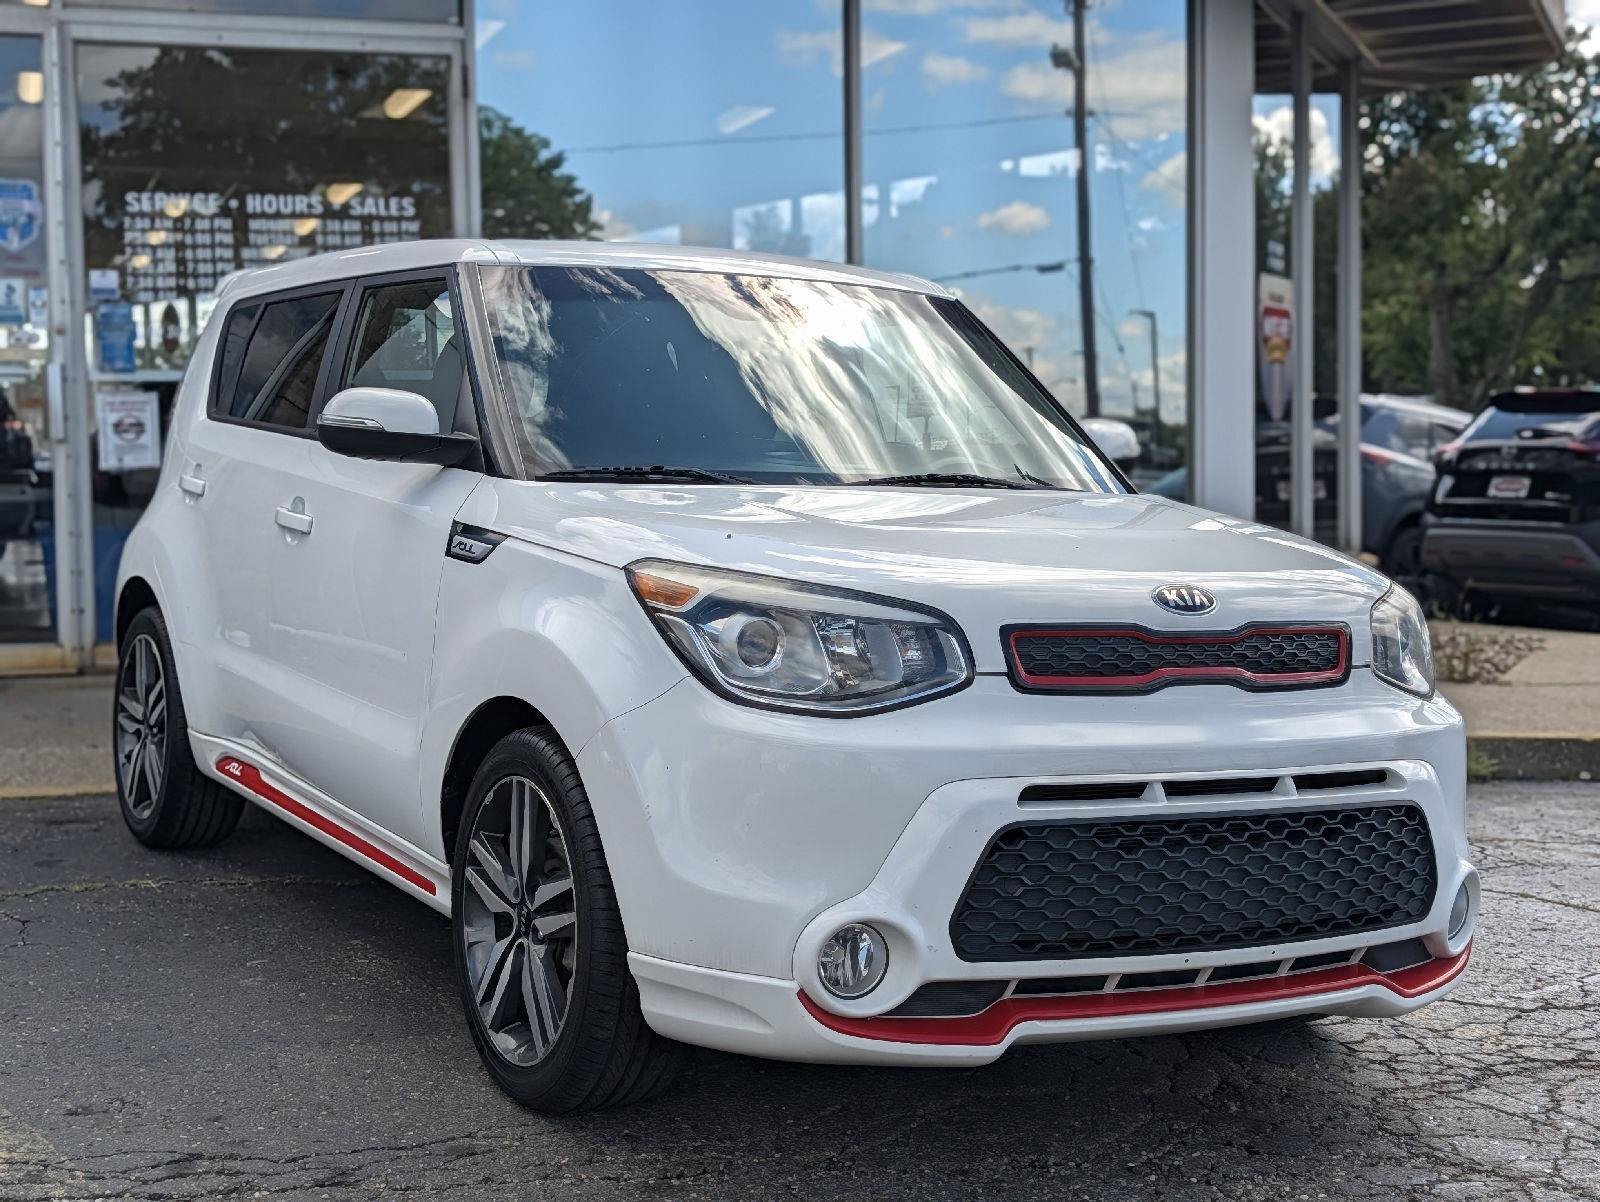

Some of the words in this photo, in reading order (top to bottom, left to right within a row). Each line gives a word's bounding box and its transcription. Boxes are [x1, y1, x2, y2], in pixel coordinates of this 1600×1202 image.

[124, 192, 220, 213] SERVICE
[245, 193, 324, 214] HOURS
[349, 196, 416, 217] SALES
[1161, 588, 1210, 606] KIA
